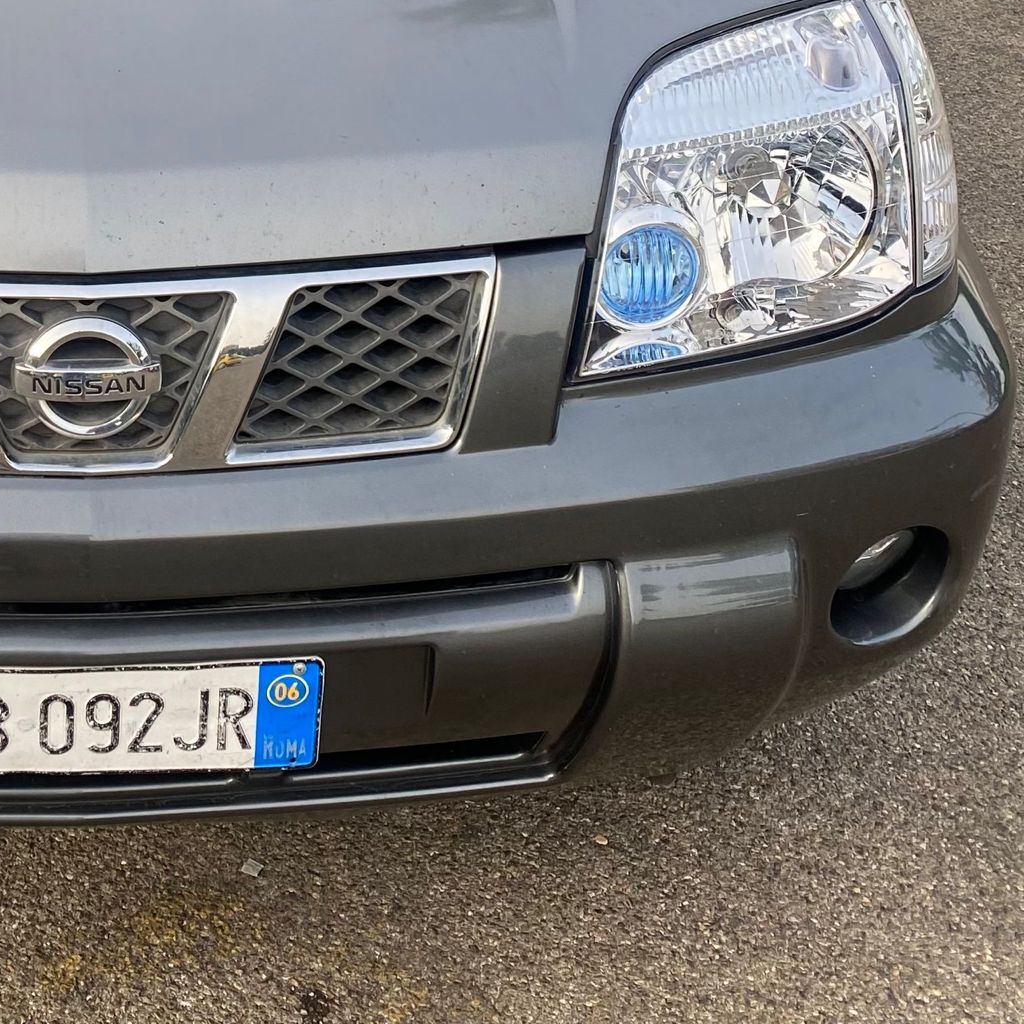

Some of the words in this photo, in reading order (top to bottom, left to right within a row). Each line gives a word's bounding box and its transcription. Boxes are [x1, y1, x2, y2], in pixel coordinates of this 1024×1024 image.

[32, 375, 146, 395] NISSAN
[274, 682, 300, 702] 06
[39, 691, 165, 755] 092
[173, 687, 254, 752] JR
